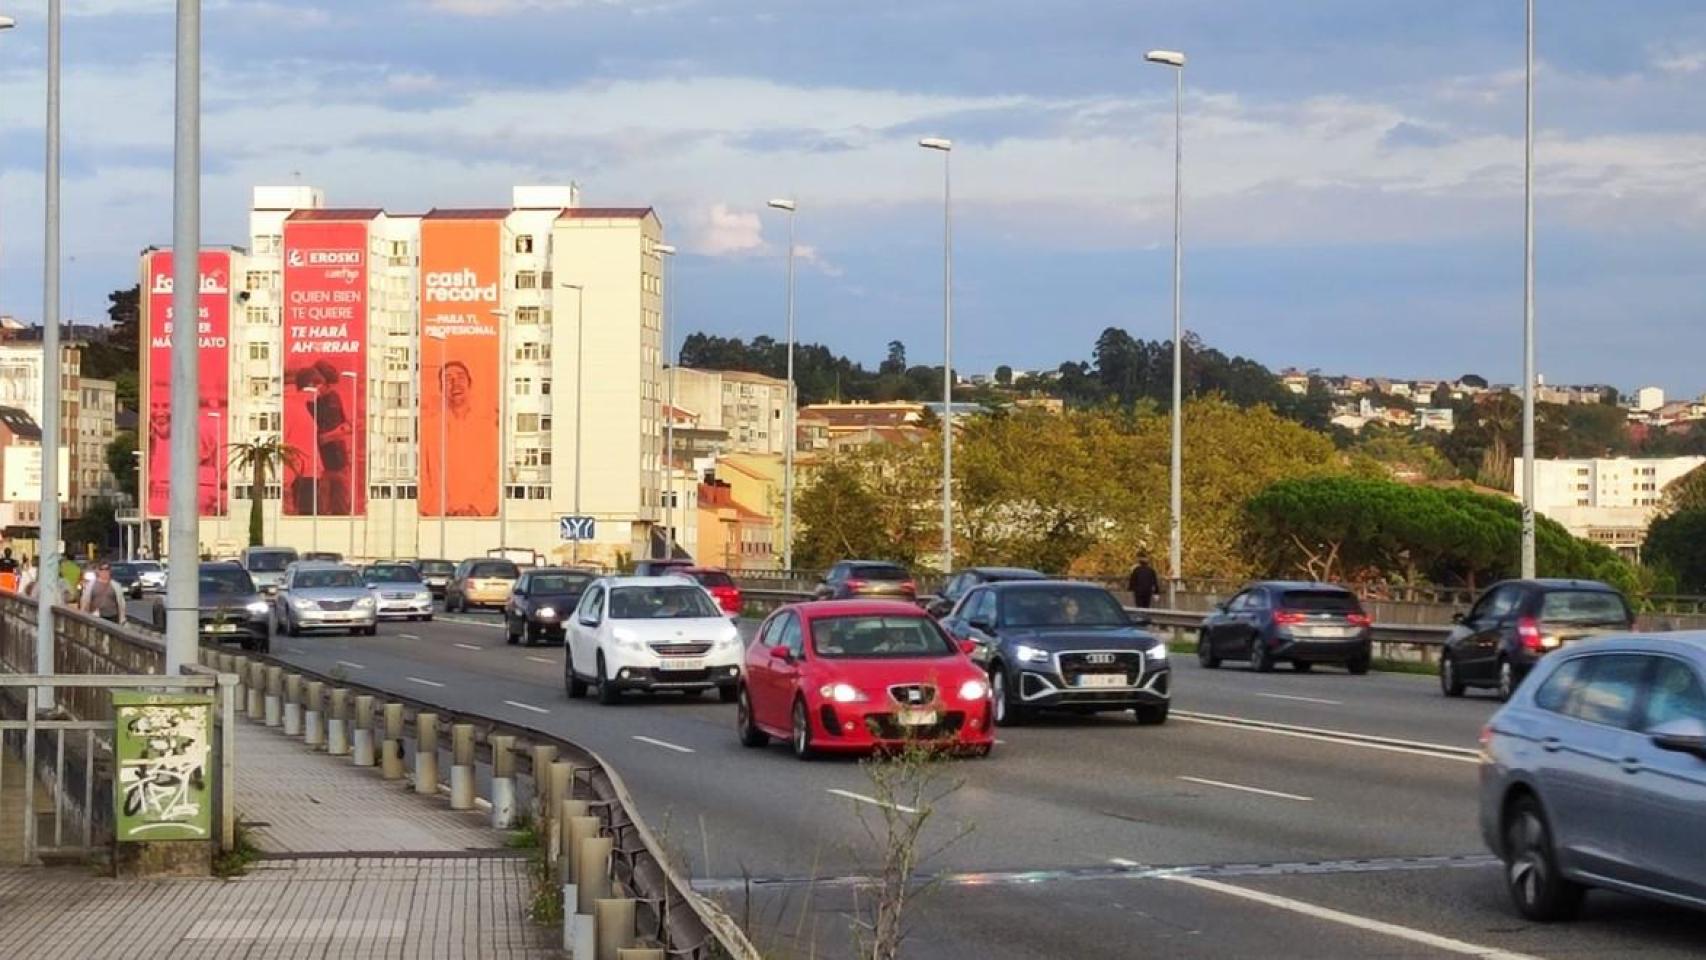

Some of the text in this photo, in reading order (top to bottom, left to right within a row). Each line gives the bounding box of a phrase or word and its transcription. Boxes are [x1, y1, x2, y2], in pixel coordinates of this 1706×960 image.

[310, 252, 360, 263] EROSKI
[426, 267, 476, 288] cash
[291, 290, 361, 304] QUIEN BIEN
[426, 282, 497, 302] record
[291, 307, 354, 321] TE QUIERE
[291, 323, 348, 337] TE HARÁ
